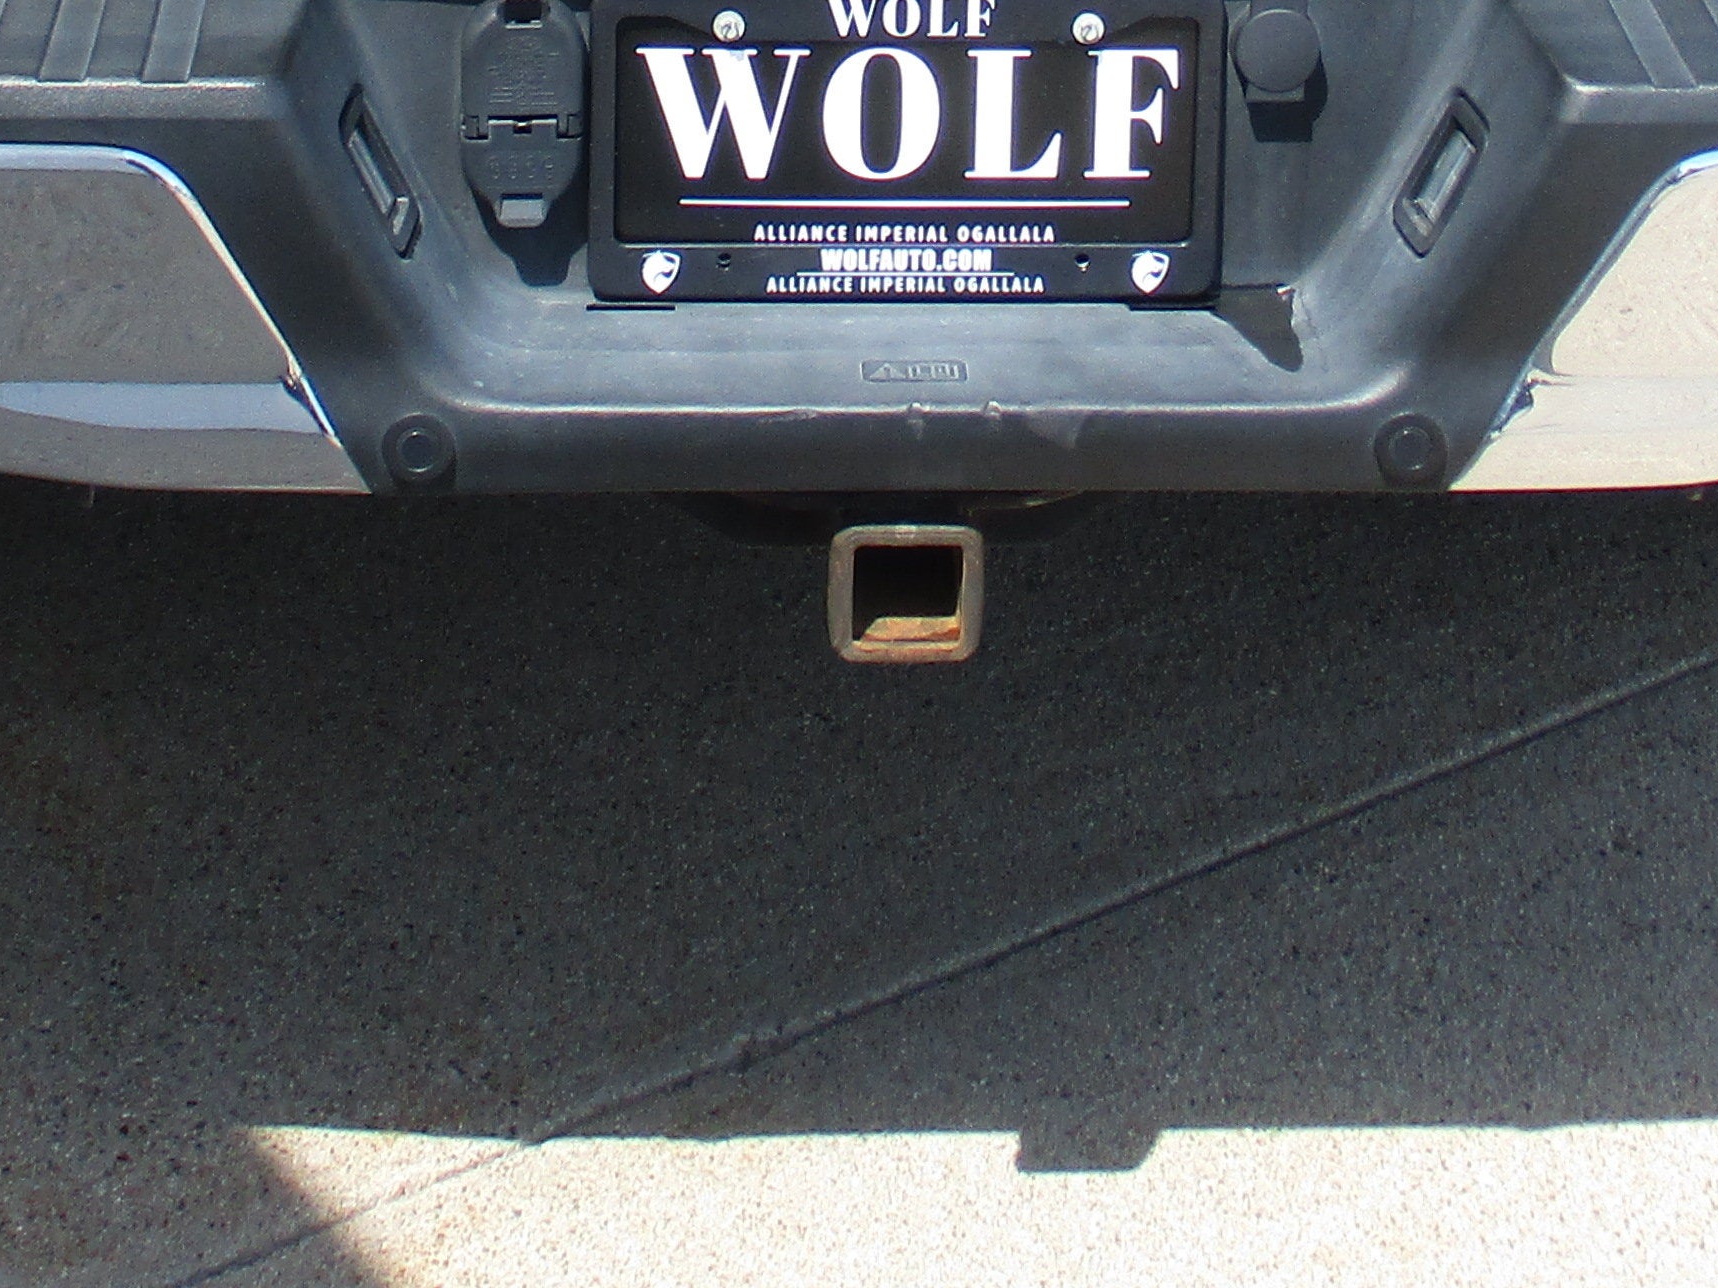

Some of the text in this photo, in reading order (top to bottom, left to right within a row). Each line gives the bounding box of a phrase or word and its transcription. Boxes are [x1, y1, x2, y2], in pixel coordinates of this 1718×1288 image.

[635, 46, 1180, 180] WOLF
[753, 224, 1056, 243] ALLIANCE IMPERIAL OGALLALA
[819, 248, 993, 272] WOLFAUTO.COM
[765, 276, 1046, 294] ALLIANCE IMPERIAL OGALLALA
